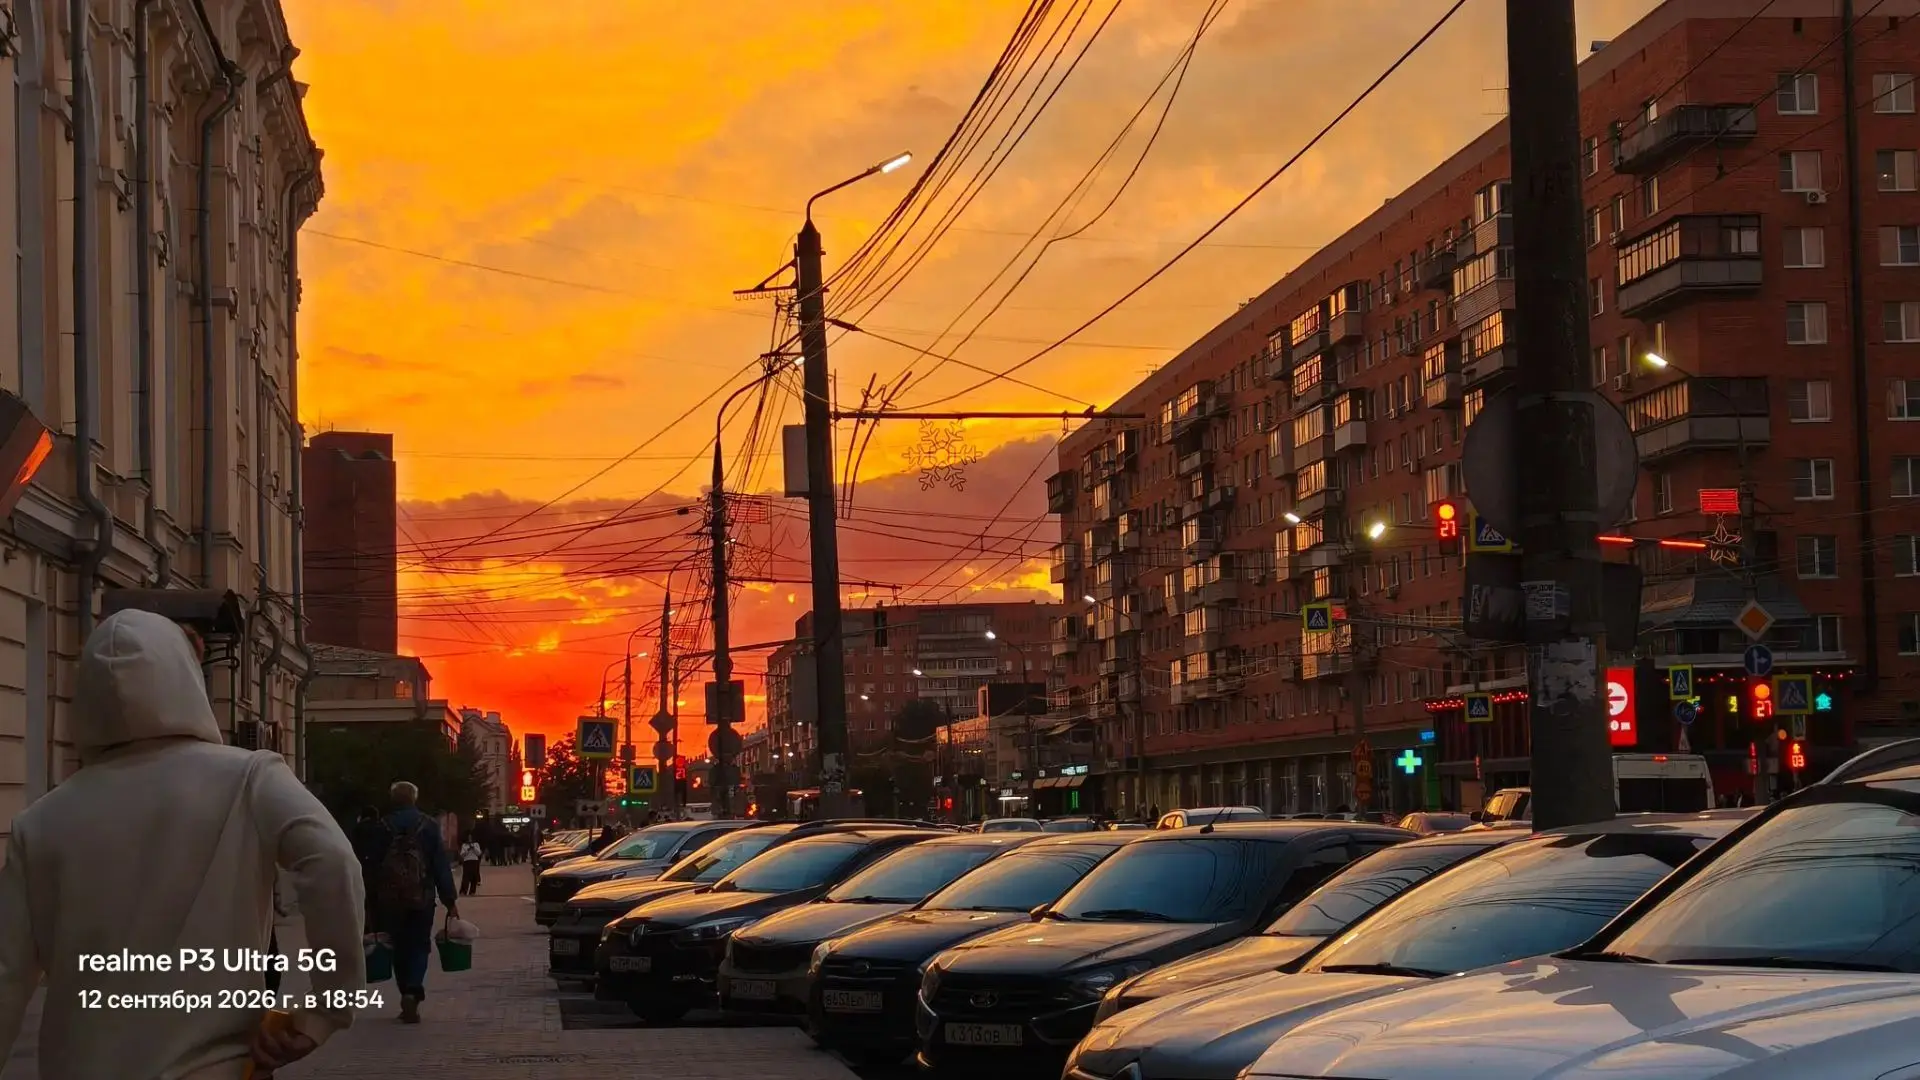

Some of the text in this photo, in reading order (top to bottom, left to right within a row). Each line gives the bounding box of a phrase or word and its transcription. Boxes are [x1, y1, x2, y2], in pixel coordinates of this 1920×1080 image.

[1440, 521, 1456, 538] 27
[1757, 700, 1772, 717] 27
[1792, 755, 1805, 768] 03
